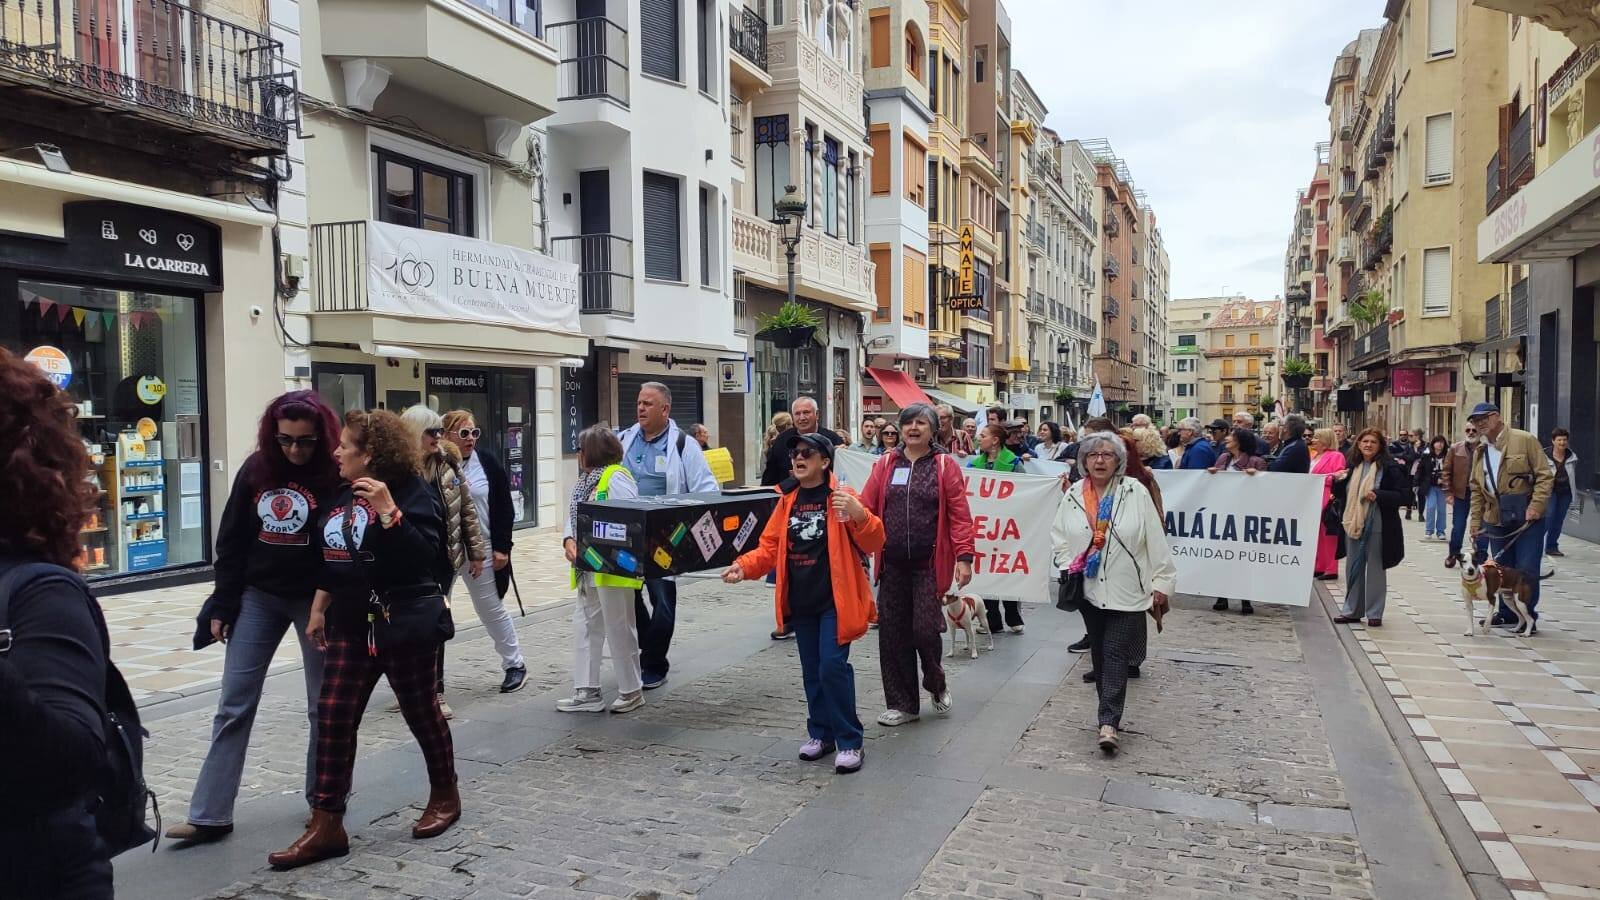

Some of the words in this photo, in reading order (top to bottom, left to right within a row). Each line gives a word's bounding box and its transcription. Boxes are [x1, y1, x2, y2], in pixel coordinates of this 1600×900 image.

[124, 253, 144, 268] LA
[146, 257, 209, 276] CARRERA
[452, 249, 513, 270] HERMANDAD
[962, 226, 972, 291] AMATE
[385, 256, 434, 288] 100
[453, 267, 519, 294] BUENA
[525, 279, 577, 305] MUERTE
[430, 376, 454, 386] TIENDA
[454, 377, 477, 386] OFICIAL
[565, 381, 581, 391] DON
[962, 476, 1014, 499] LUD
[973, 515, 1020, 541] EJA
[1165, 507, 1207, 538] ALÁ
[1210, 513, 1239, 541] LA
[1244, 515, 1302, 547] REAL
[1172, 545, 1235, 561] SANIDAD
[1239, 549, 1301, 566] PÚBLICA
